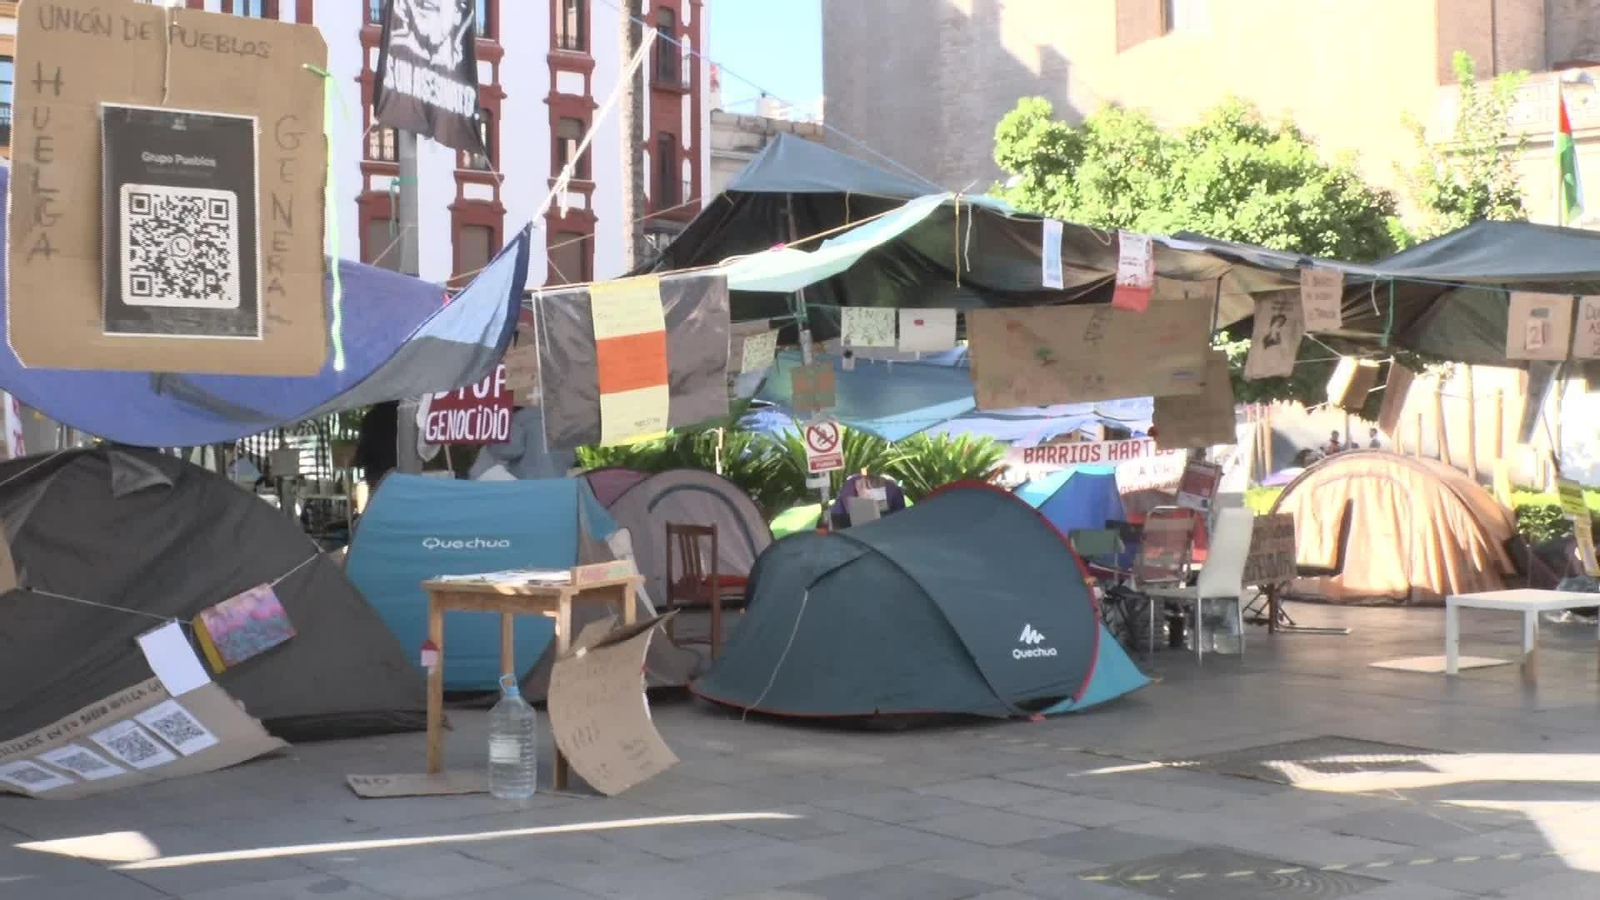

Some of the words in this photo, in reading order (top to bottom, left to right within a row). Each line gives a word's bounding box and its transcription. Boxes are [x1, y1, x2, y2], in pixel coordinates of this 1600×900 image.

[121, 15, 151, 41] DE
[168, 25, 271, 59] PUEBLOS
[141, 151, 173, 164] Grupo
[1024, 444, 1101, 464] BARRIOS
[422, 537, 510, 549] Quechua
[1012, 647, 1058, 660] Quechua
